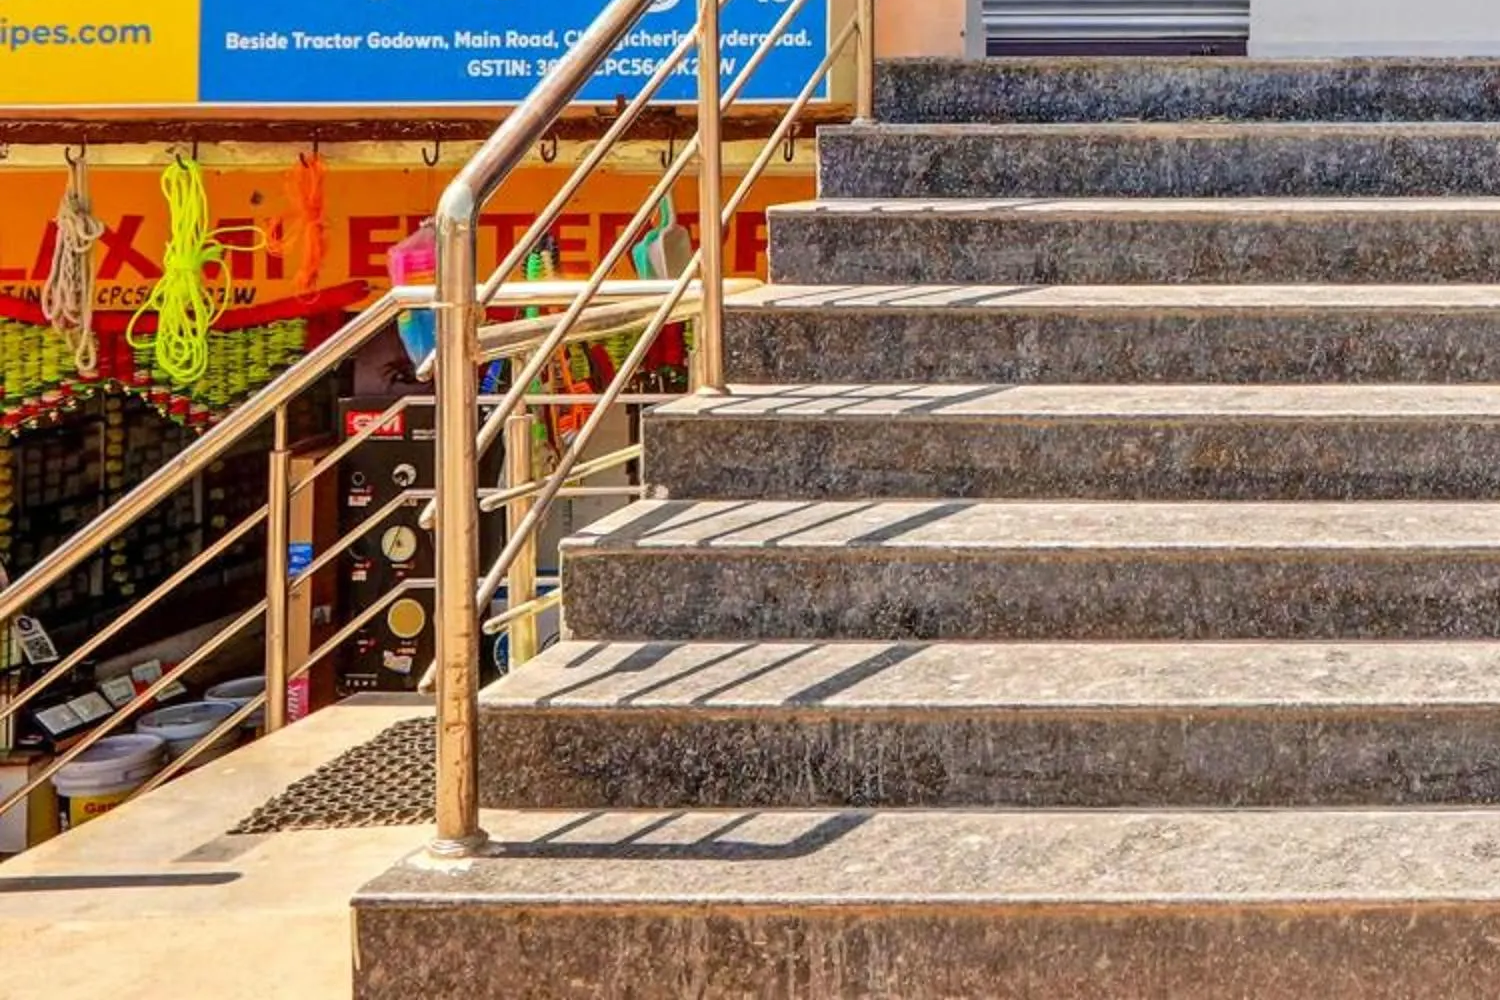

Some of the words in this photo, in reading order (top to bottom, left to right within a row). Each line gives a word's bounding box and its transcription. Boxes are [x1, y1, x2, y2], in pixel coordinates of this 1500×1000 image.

[225, 31, 288, 50] Beside
[292, 31, 362, 50] Tractor
[367, 31, 449, 50] Godown,
[454, 30, 500, 49] Main
[506, 30, 559, 50] Road,
[467, 59, 531, 77] GSTIN:
